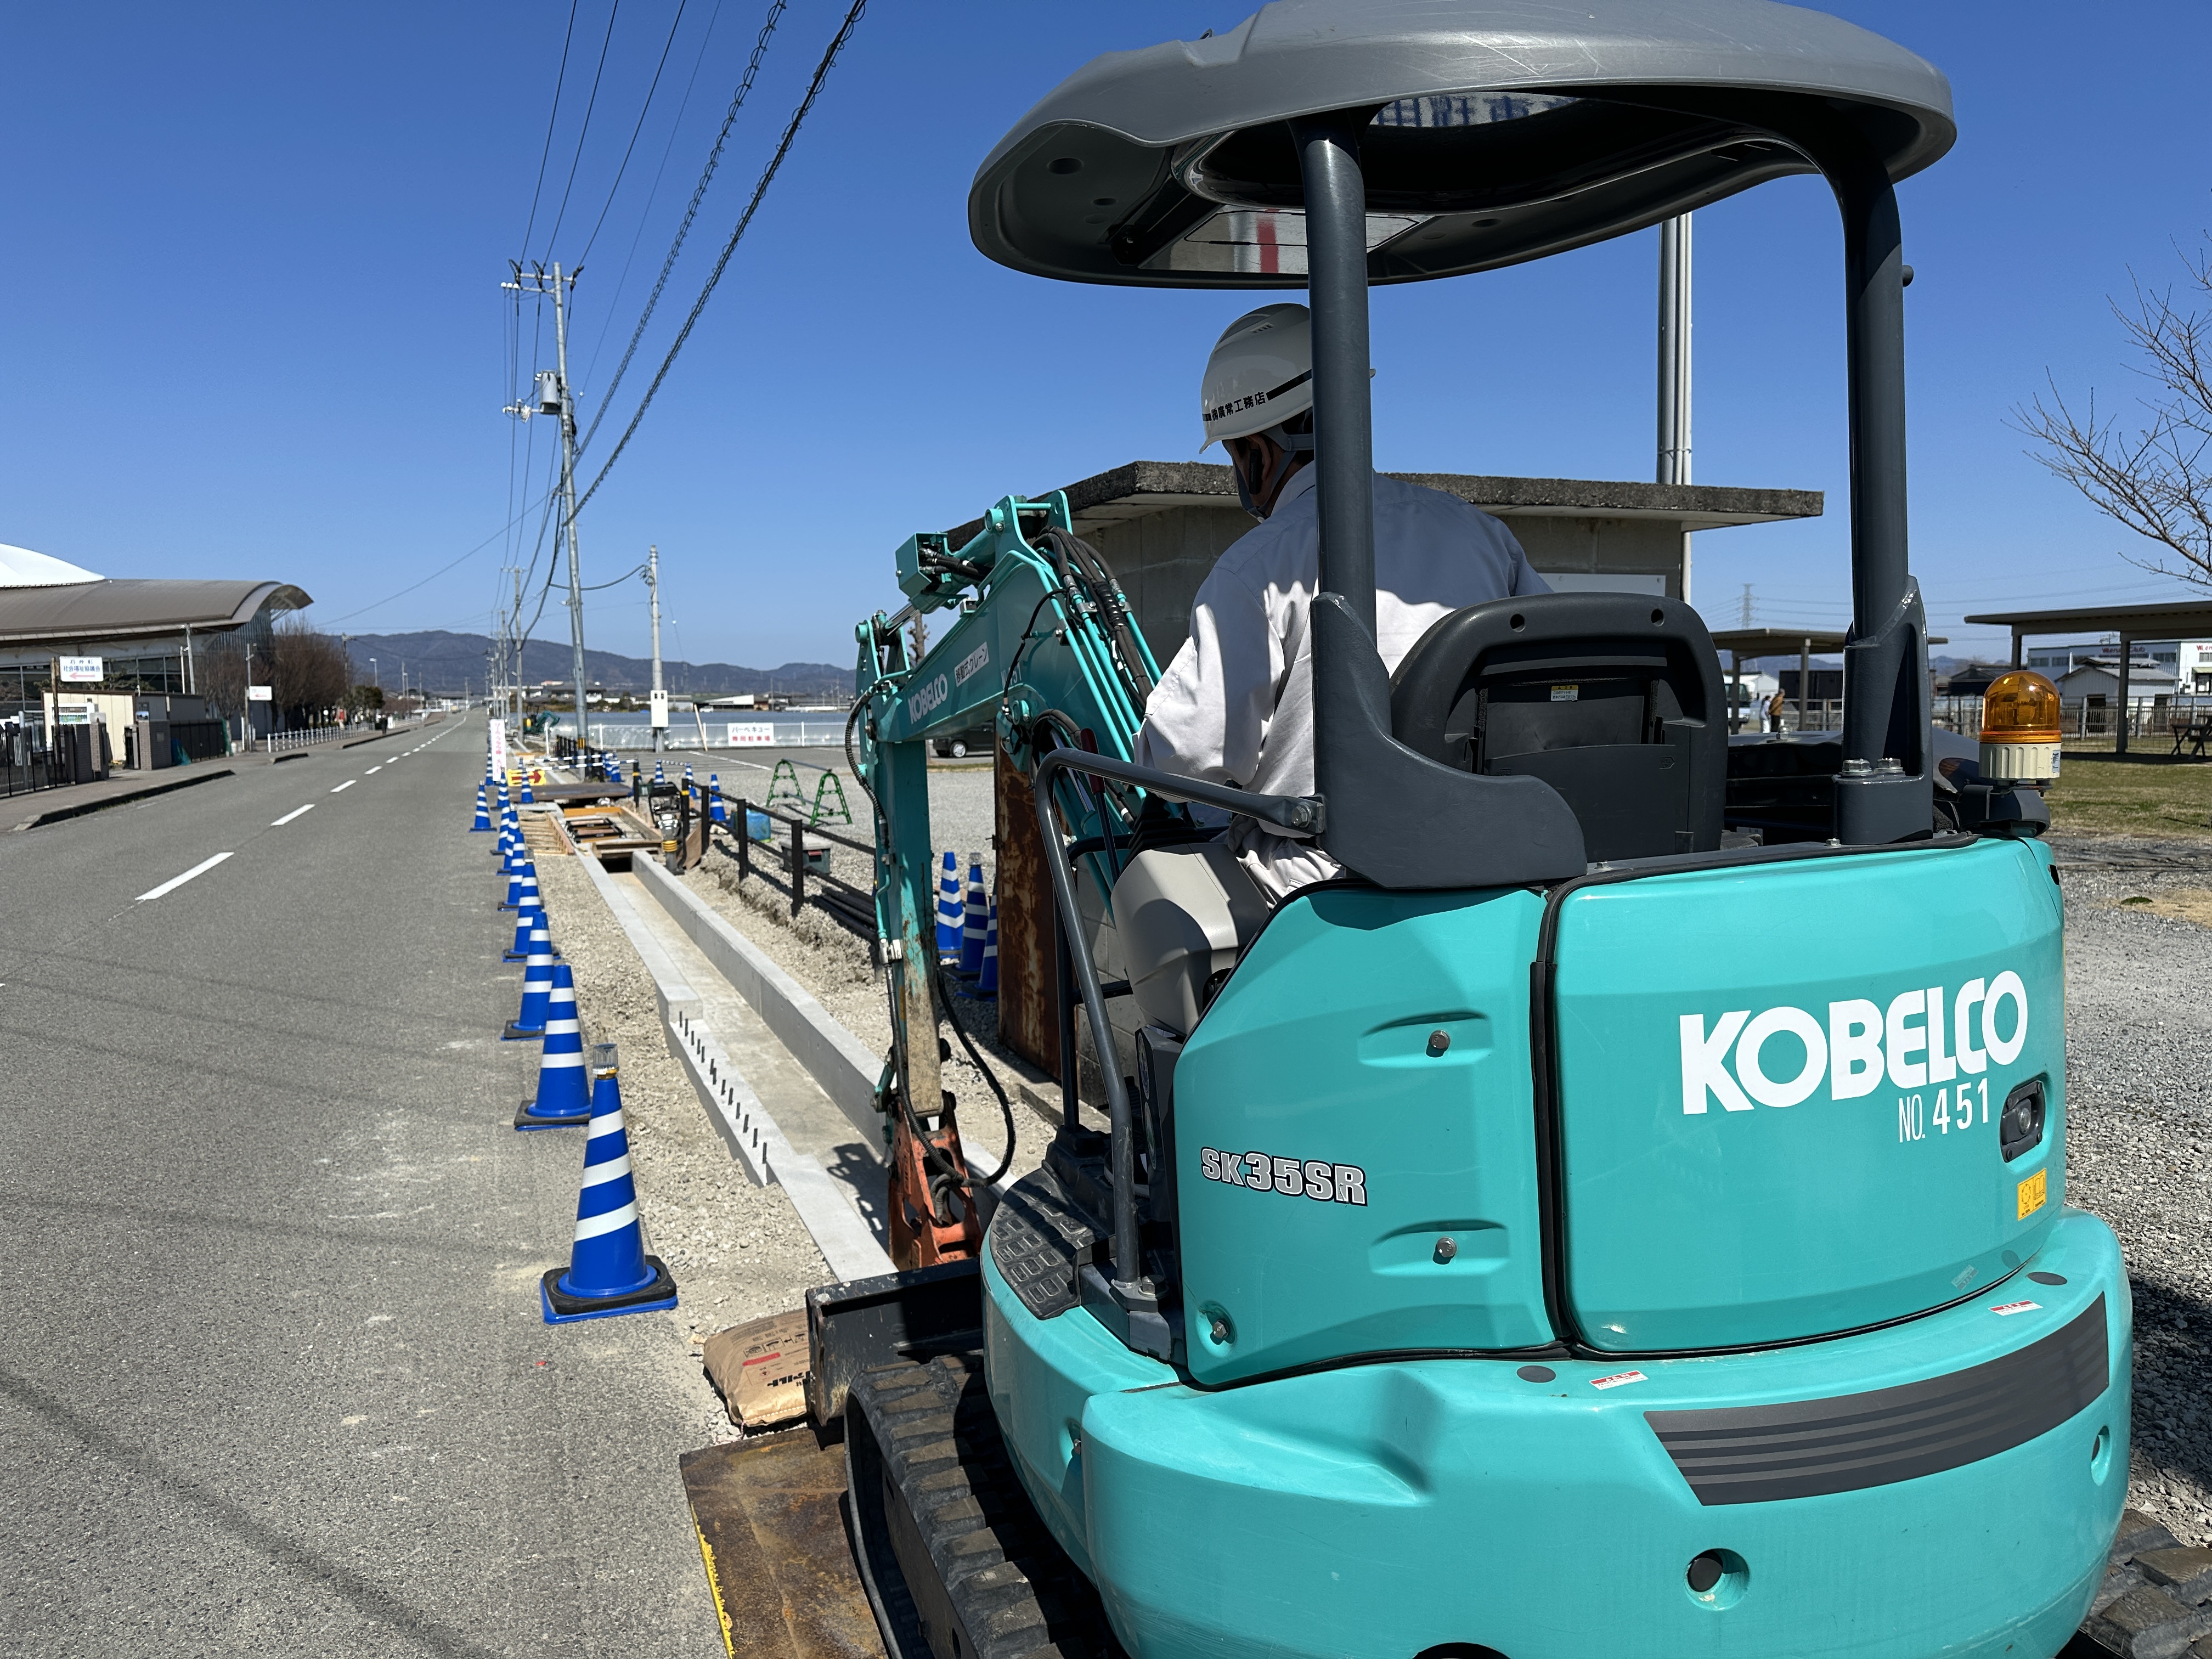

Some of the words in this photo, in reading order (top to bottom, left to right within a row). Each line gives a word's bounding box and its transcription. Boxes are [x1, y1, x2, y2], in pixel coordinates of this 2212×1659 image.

[908, 673, 948, 725] KOBELCO
[1679, 970, 2028, 1115] KOBELCO
[1932, 1077, 1988, 1136] 451
[1201, 1147, 1368, 1207] SK35SR
